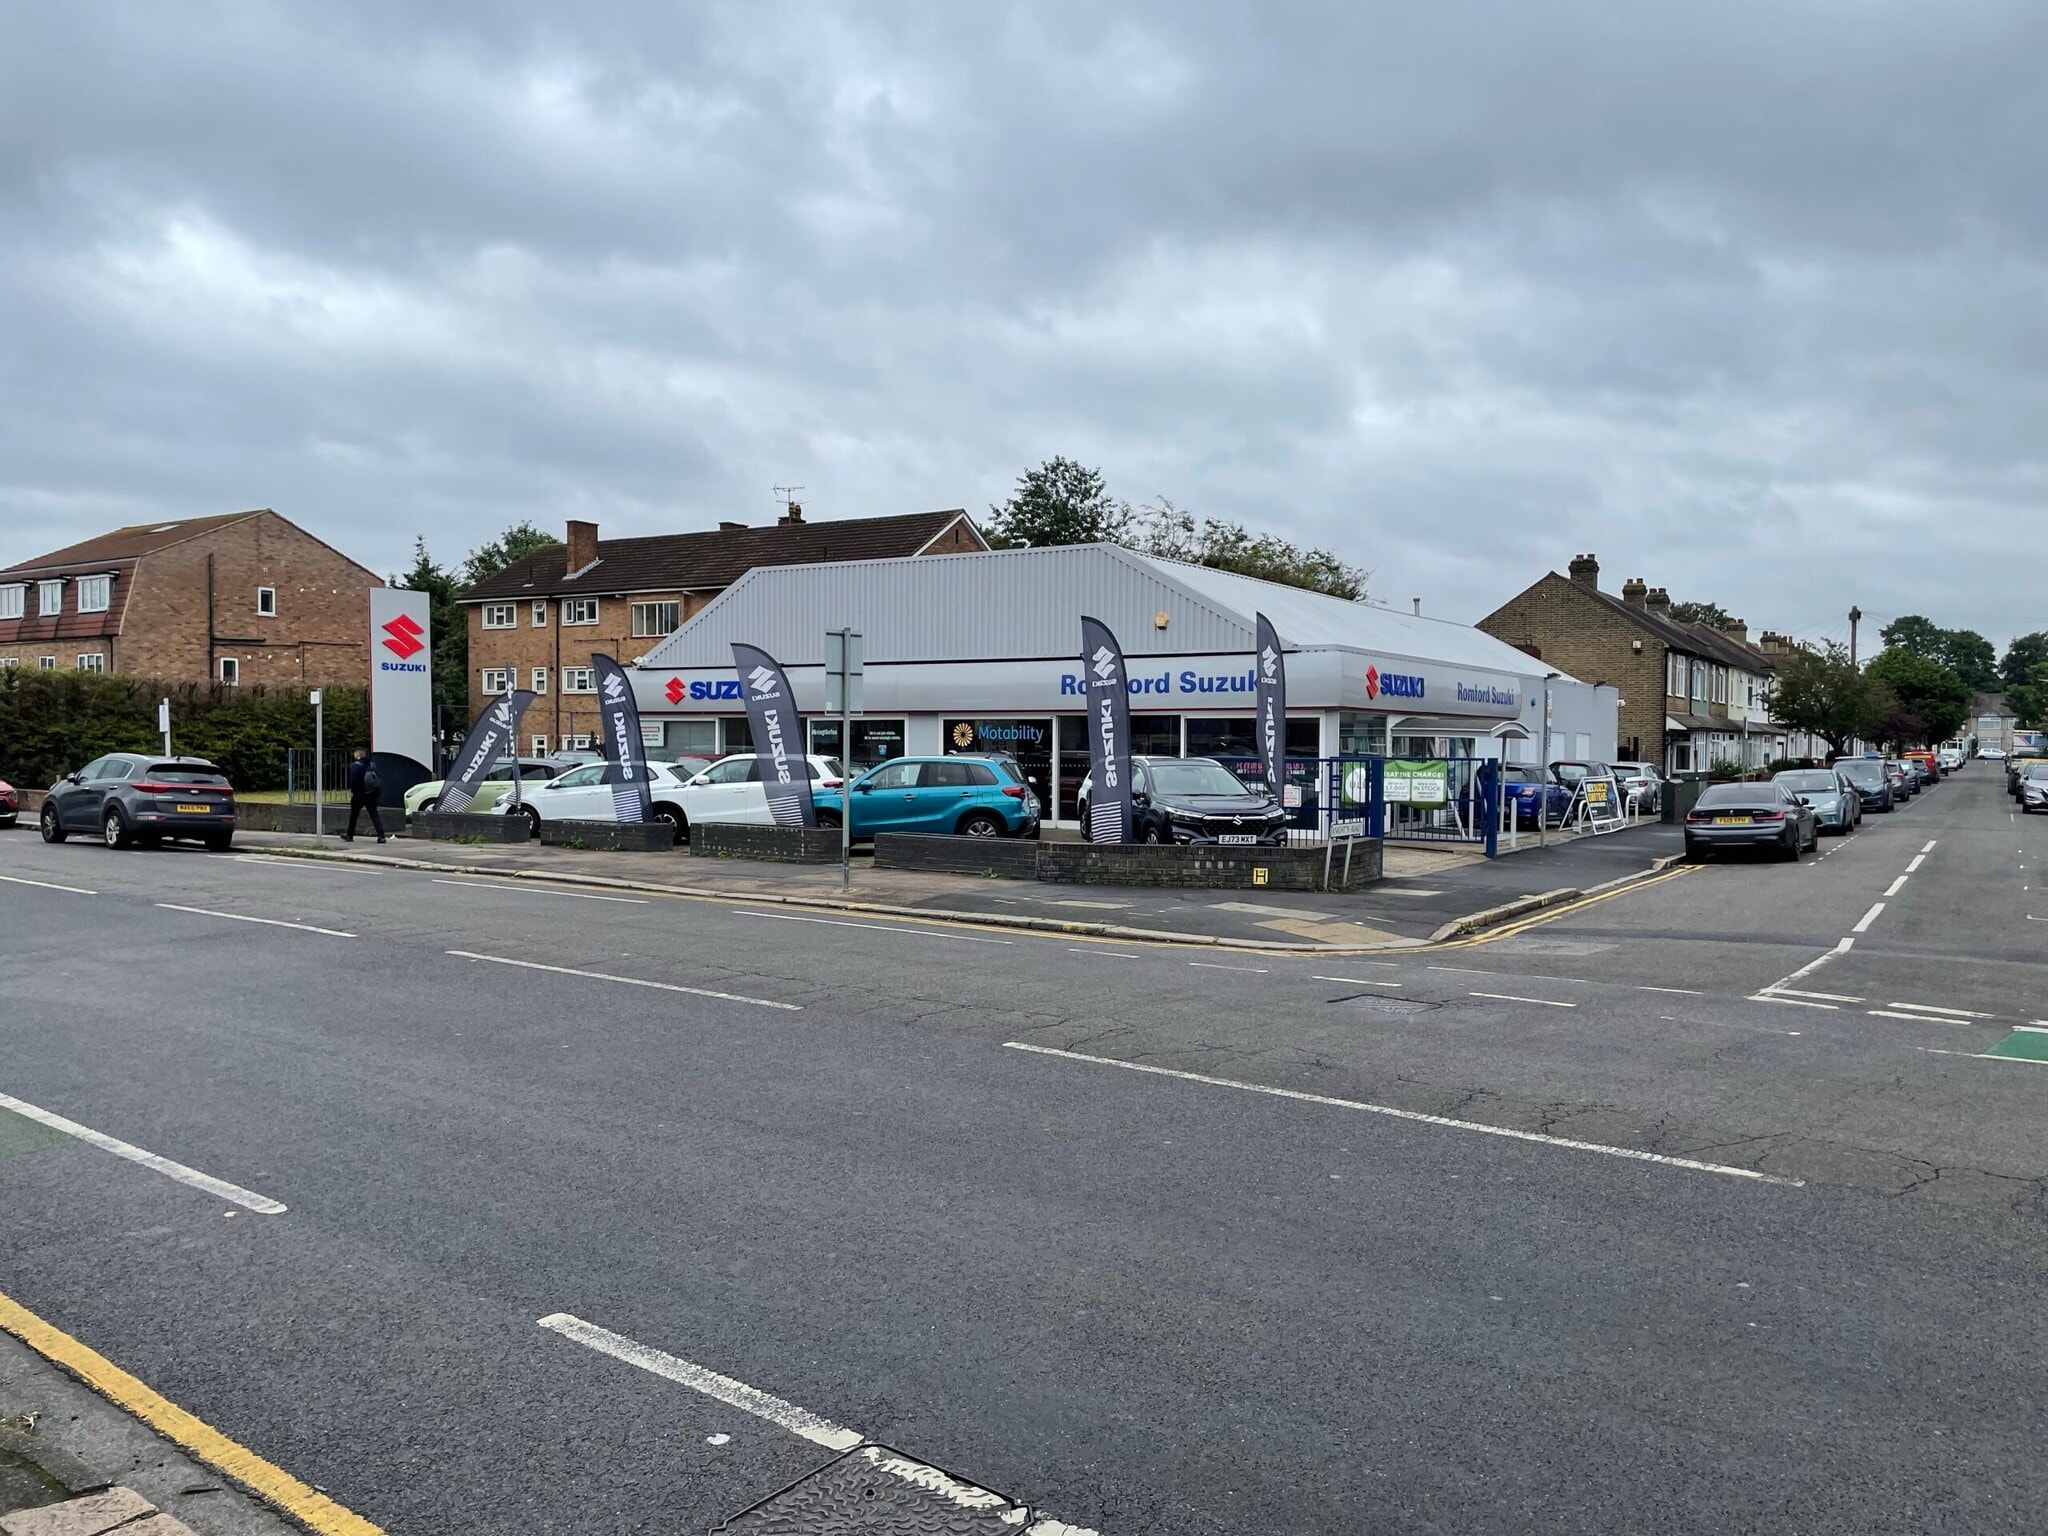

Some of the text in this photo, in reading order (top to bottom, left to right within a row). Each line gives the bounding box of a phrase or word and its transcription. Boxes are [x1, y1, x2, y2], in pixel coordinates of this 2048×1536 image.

[381, 662, 426, 672] SUZUKI
[690, 681, 745, 700] SUZ
[1061, 669, 1258, 695] Roord Suzuk
[1380, 672, 1425, 698] SUZUKI
[1457, 682, 1514, 706] Romford Suzuki
[978, 725, 1044, 744] Motability
[461, 730, 498, 783] SUZUKI
[1255, 869, 1266, 883] H
